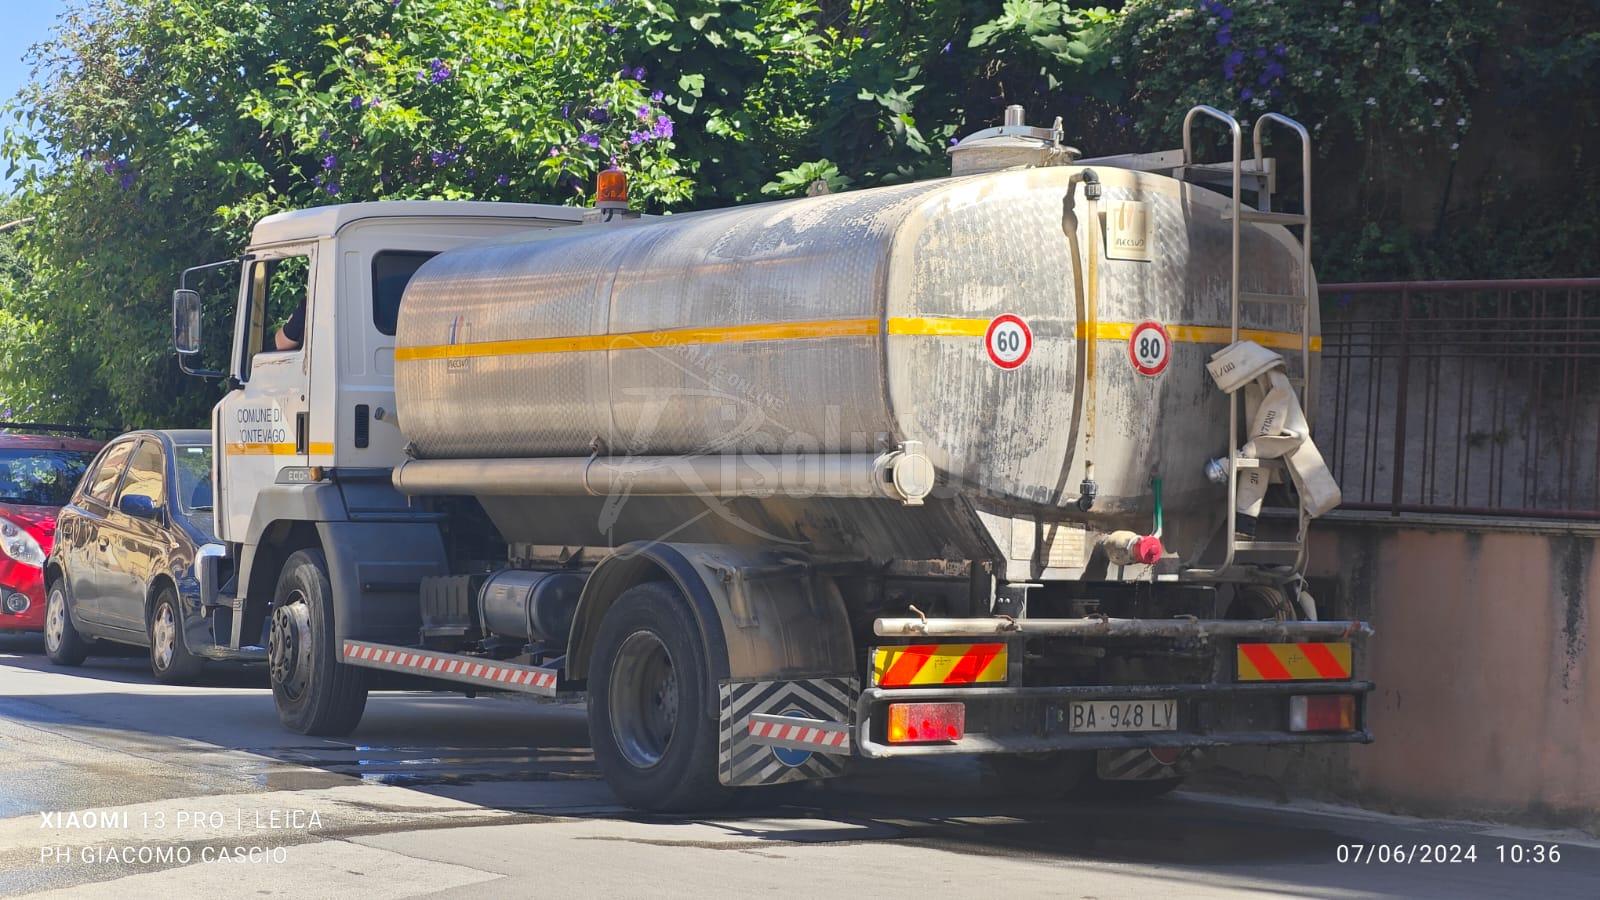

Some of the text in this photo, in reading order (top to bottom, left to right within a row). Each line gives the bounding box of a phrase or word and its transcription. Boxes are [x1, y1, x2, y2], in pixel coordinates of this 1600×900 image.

[997, 330, 1020, 352] 60
[1140, 337, 1160, 359] 80
[237, 408, 283, 423] COMUNE DI
[240, 428, 286, 443] ONTEVAGO
[1073, 703, 1097, 728] BA
[1109, 703, 1144, 728] 948
[1151, 703, 1174, 728] LV
